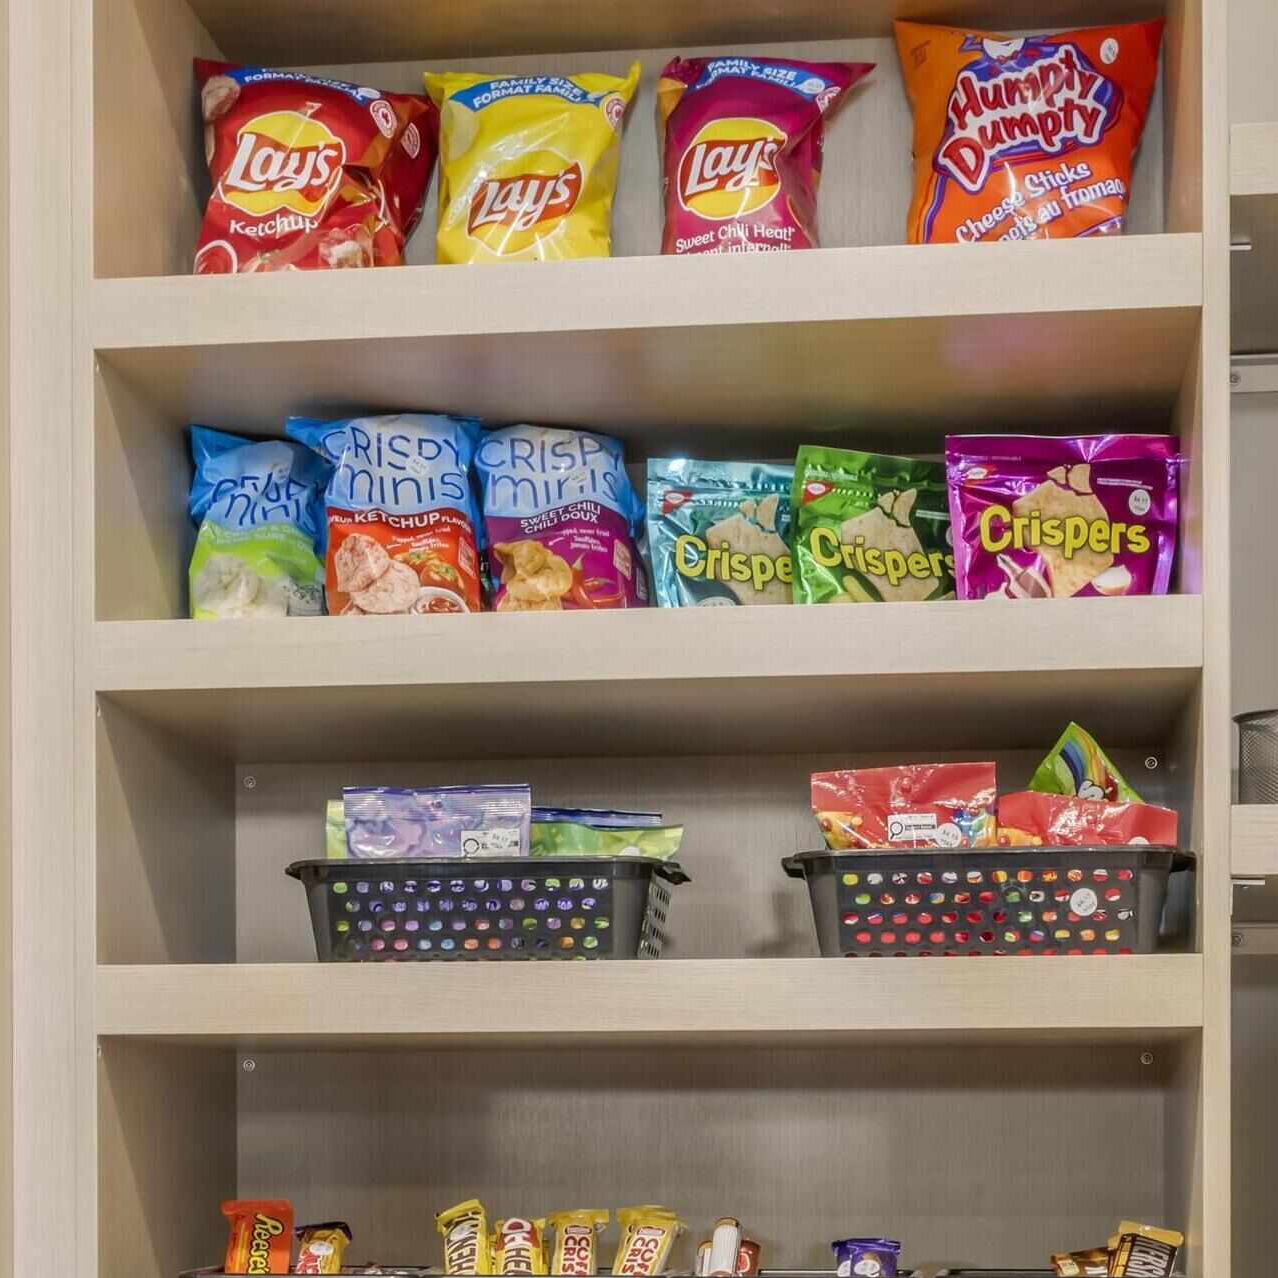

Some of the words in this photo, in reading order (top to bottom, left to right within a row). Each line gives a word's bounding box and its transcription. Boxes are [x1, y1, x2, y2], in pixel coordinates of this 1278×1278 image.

[490, 77, 546, 90] FAMILY
[550, 77, 582, 96] SIZE
[763, 67, 798, 80] SIZE
[949, 48, 1101, 132] Humpty
[473, 85, 530, 108] FORMAT
[225, 134, 338, 193] Lay's
[942, 100, 1100, 185] Dumpty
[684, 135, 778, 197] Lay's
[471, 169, 572, 232] Lay's
[955, 190, 1025, 243] Cheese
[1024, 162, 1091, 198] Sticks
[1037, 202, 1062, 224] au
[229, 213, 317, 237] Ketchup
[676, 231, 715, 253] Sweet
[718, 223, 749, 240] Chili
[322, 426, 460, 470] CRISPY
[328, 463, 464, 505] minis
[355, 511, 440, 529] KETCHUP
[521, 508, 563, 528] SWEET
[569, 501, 601, 515] CHILI
[525, 519, 557, 534] CHILI
[561, 512, 598, 524] DOUX
[980, 504, 1150, 559] Crispers
[675, 534, 793, 590] Crispe
